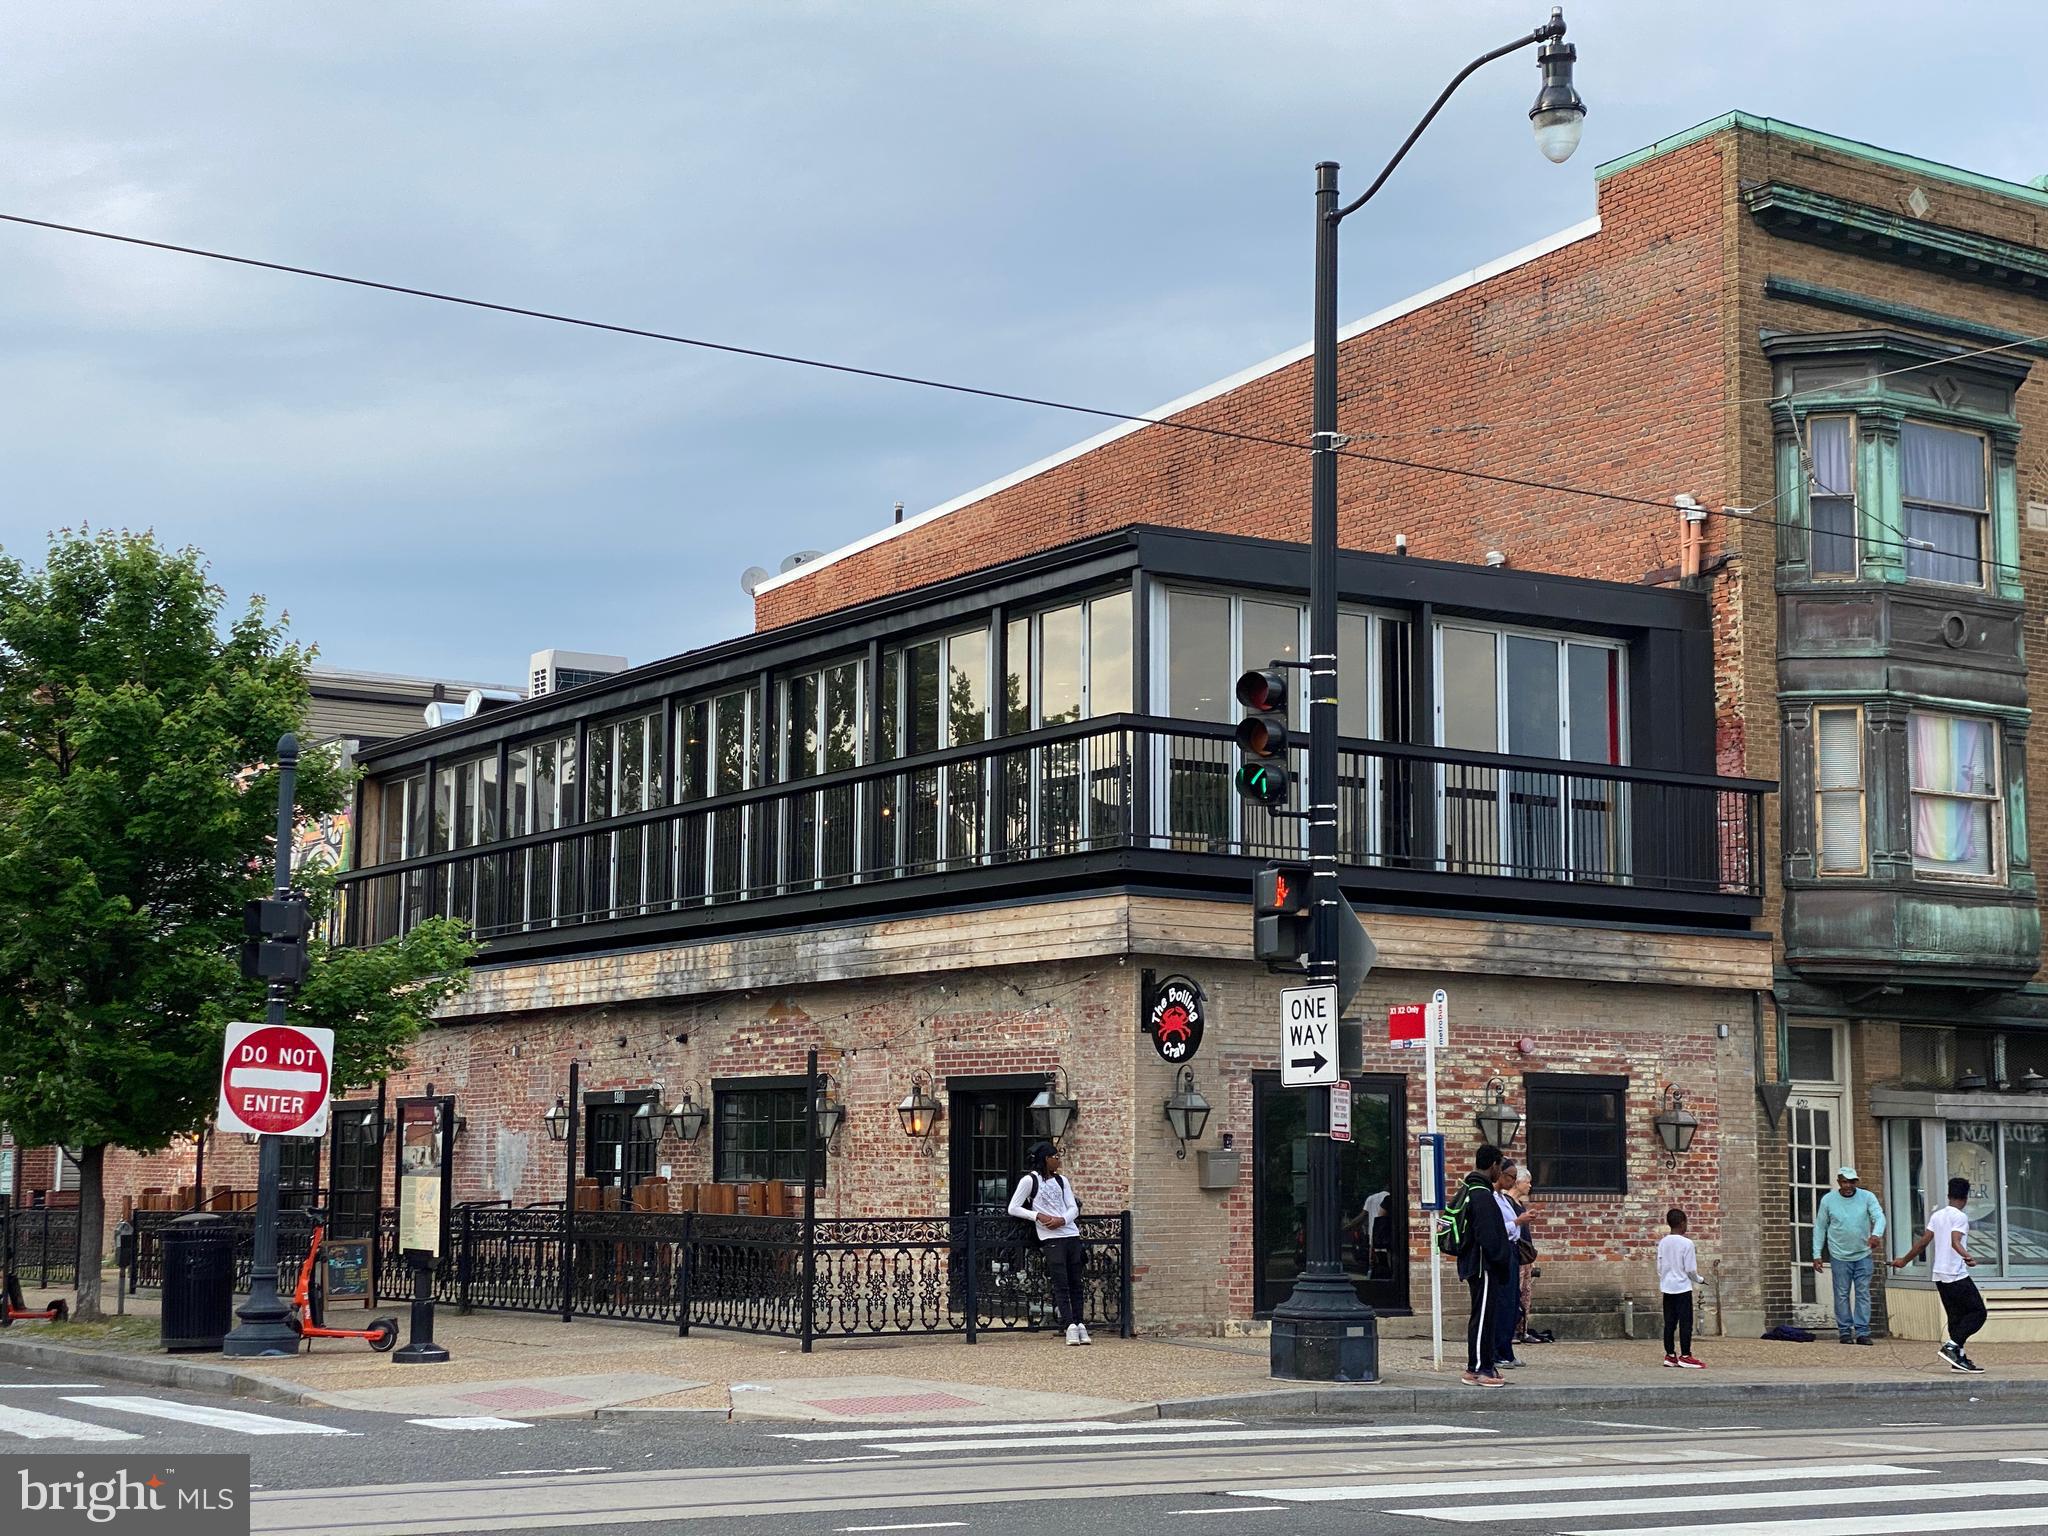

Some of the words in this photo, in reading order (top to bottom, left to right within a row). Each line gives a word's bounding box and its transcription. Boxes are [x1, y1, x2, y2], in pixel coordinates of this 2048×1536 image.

[1151, 998, 1168, 1023] The
[1168, 987, 1199, 1023] Boiling
[1291, 997, 1327, 1020] ONE
[1389, 1007, 1397, 1015] X1
[1398, 1006, 1406, 1015] X2
[1406, 1005, 1420, 1015] Only
[1290, 1023, 1328, 1046] WAY
[241, 1045, 268, 1063] DO
[279, 1047, 317, 1066] NOT
[1163, 1041, 1186, 1058] Crab
[243, 1094, 304, 1114] ENTER
